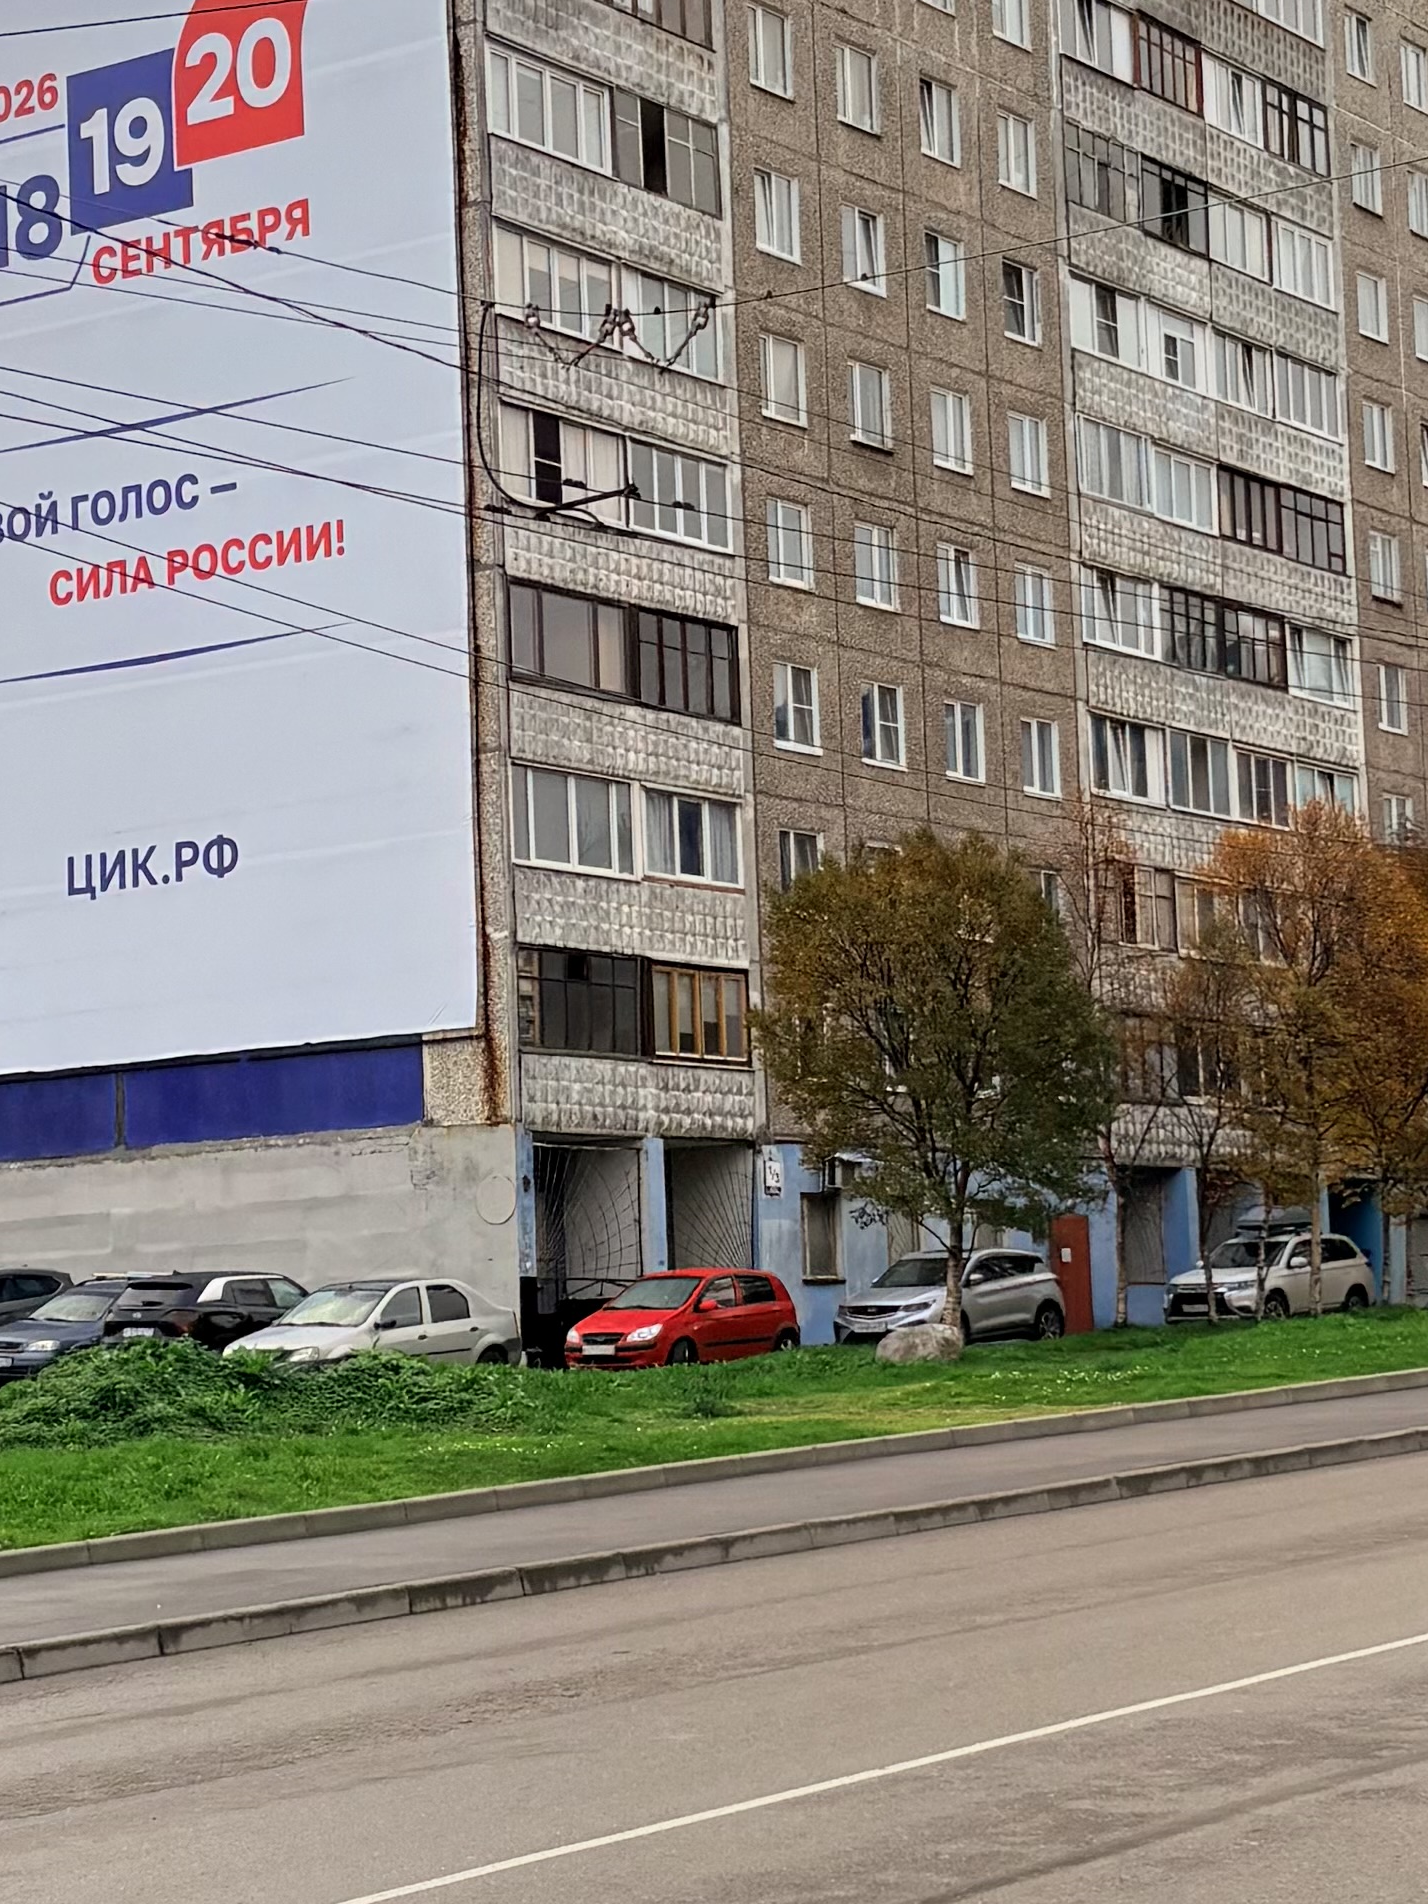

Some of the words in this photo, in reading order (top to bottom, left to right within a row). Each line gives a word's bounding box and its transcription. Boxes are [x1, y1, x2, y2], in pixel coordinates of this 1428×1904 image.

[184, 17, 292, 127] 20
[79, 96, 165, 196] 19
[91, 197, 310, 285] СЕНТЯБРЯ
[71, 472, 199, 531] ГОЛОС
[49, 555, 155, 607] СИЛА
[167, 519, 345, 586] РОССИИ!
[67, 834, 239, 901] ЦИК.РФ
